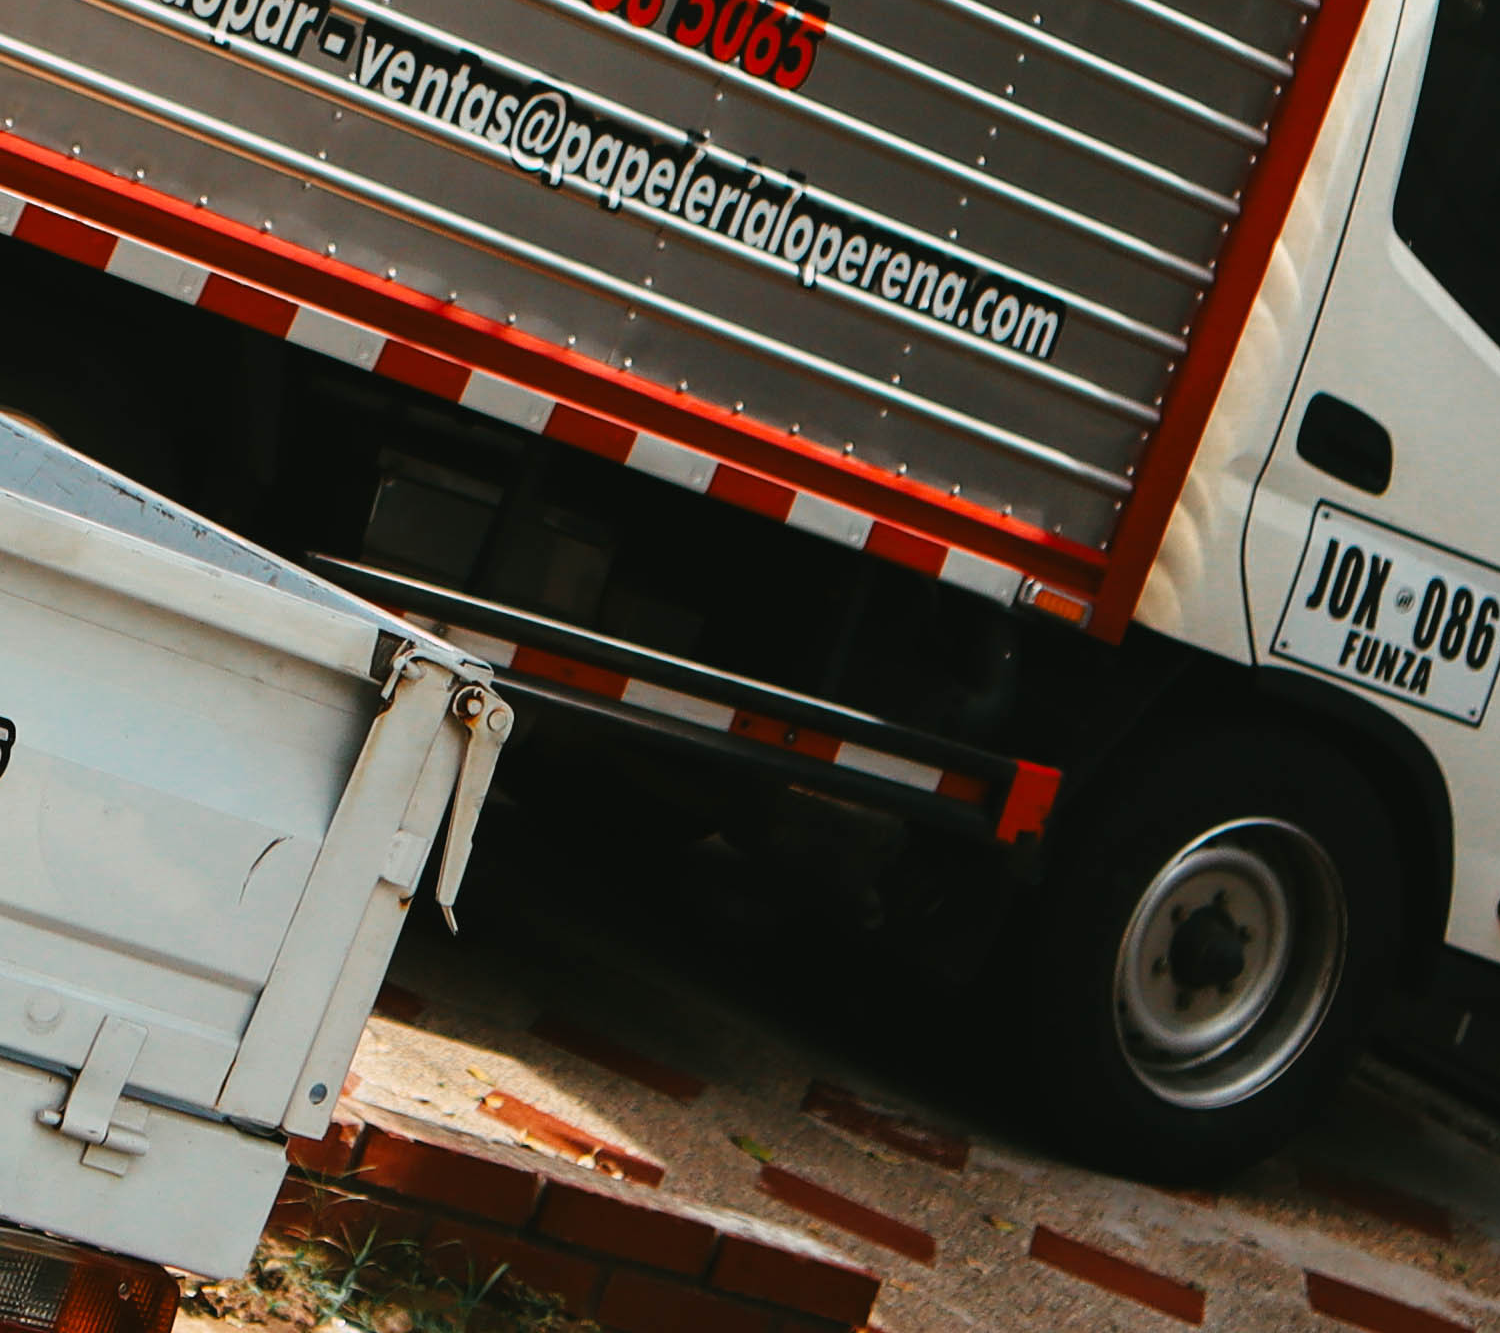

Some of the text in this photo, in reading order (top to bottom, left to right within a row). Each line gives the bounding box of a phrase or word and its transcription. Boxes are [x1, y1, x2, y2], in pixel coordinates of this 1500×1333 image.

[1306, 539, 1500, 670] JOX 086
[1339, 630, 1433, 696] FUNZA
